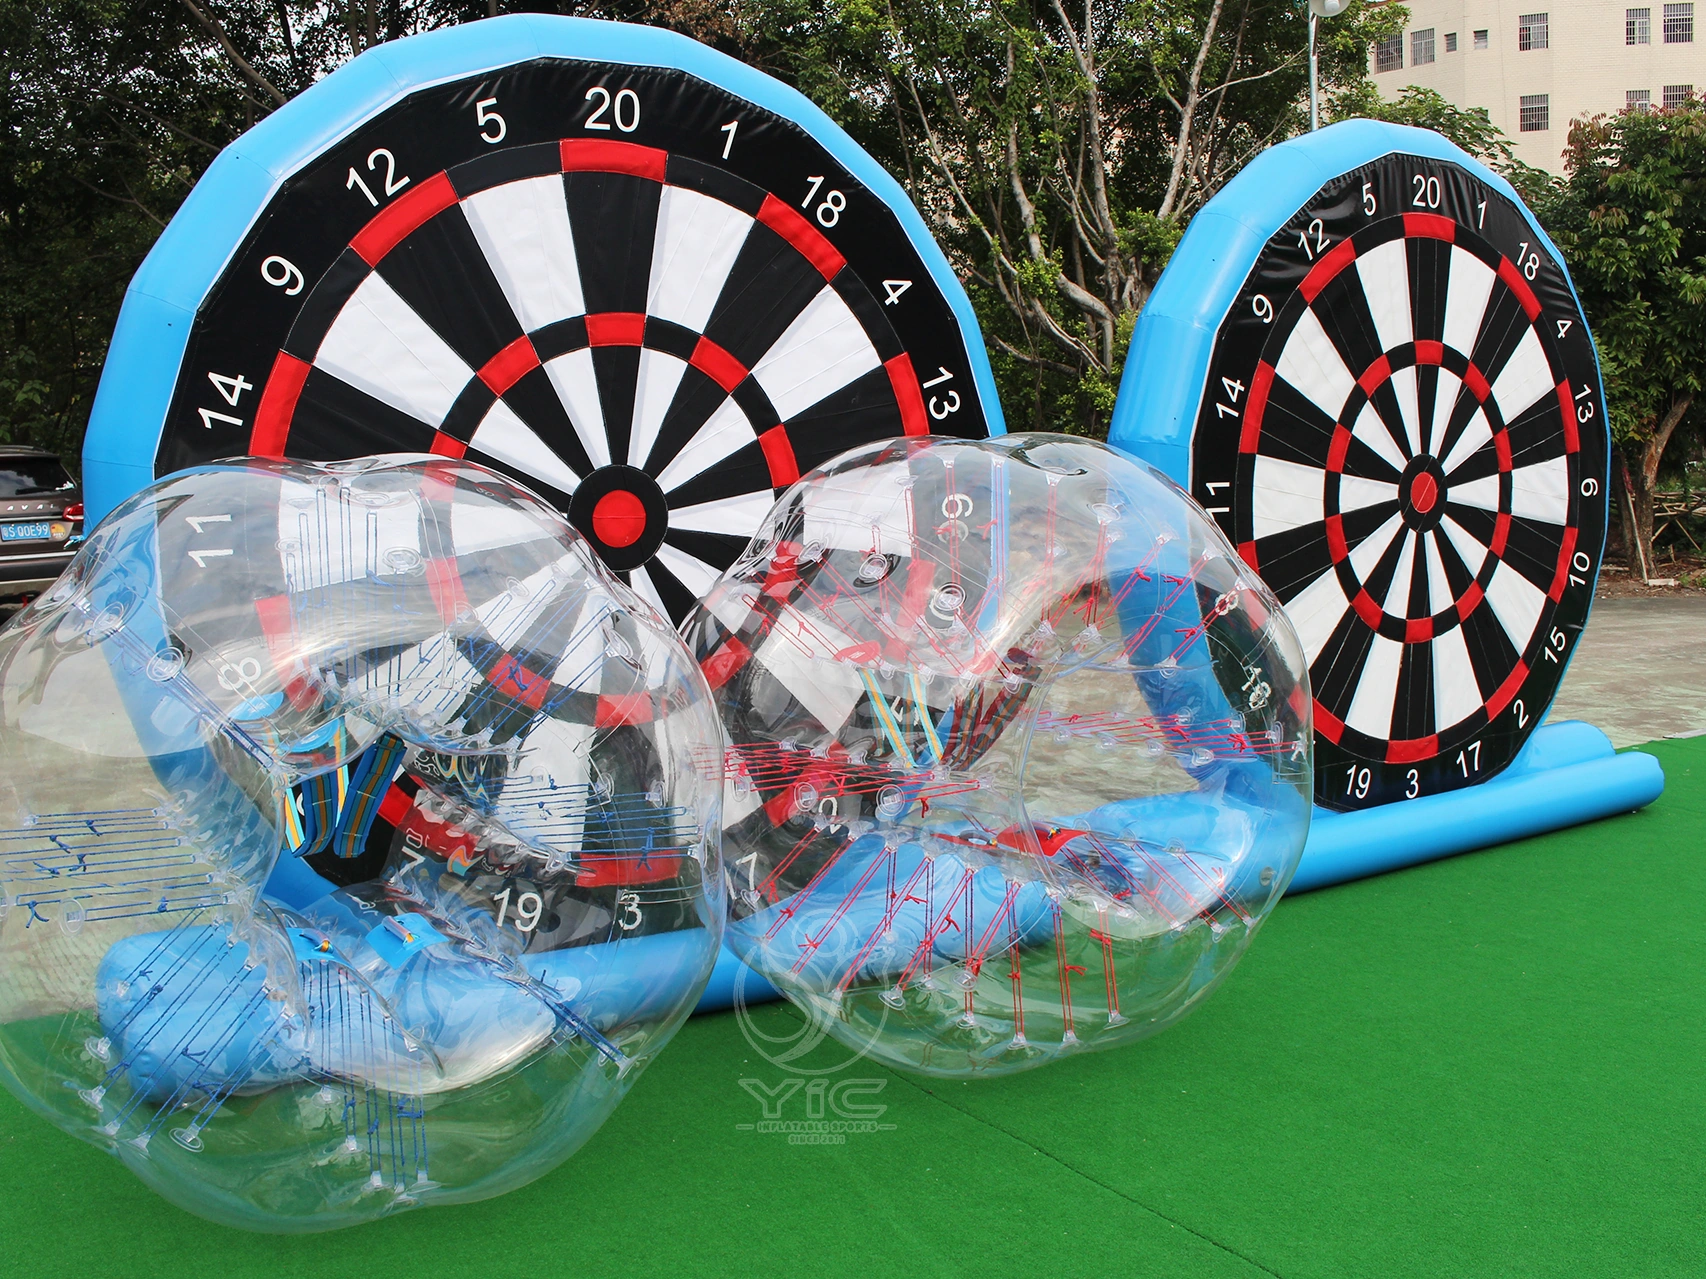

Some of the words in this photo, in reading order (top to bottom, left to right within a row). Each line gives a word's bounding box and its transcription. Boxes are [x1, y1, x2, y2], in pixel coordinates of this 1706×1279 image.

[476, 97, 507, 143] 5
[585, 87, 640, 132] 20
[720, 120, 739, 160] 1
[345, 148, 410, 207] 12
[1412, 174, 1441, 209] 20
[801, 175, 847, 228] 18
[1362, 182, 1377, 216] 5
[1477, 200, 1487, 230] 1
[1297, 218, 1331, 261] 12
[260, 255, 305, 296] 9
[1516, 242, 1540, 281] 18
[881, 278, 913, 306] 4
[1252, 294, 1273, 324] 9
[1556, 319, 1573, 339] 4
[198, 371, 253, 429] 14
[922, 366, 961, 420] 13
[1215, 376, 1245, 419] 14
[1574, 383, 1594, 424] 13
[1205, 481, 1231, 521] 11
[185, 514, 234, 567] 11
[1568, 549, 1590, 589] 10
[1544, 626, 1566, 664] 15
[1513, 699, 1529, 729] 2
[1456, 740, 1481, 778] 17
[1346, 764, 1371, 799] 19
[1405, 768, 1419, 799] 3
[493, 888, 544, 931] 19
[617, 889, 643, 931] 3
